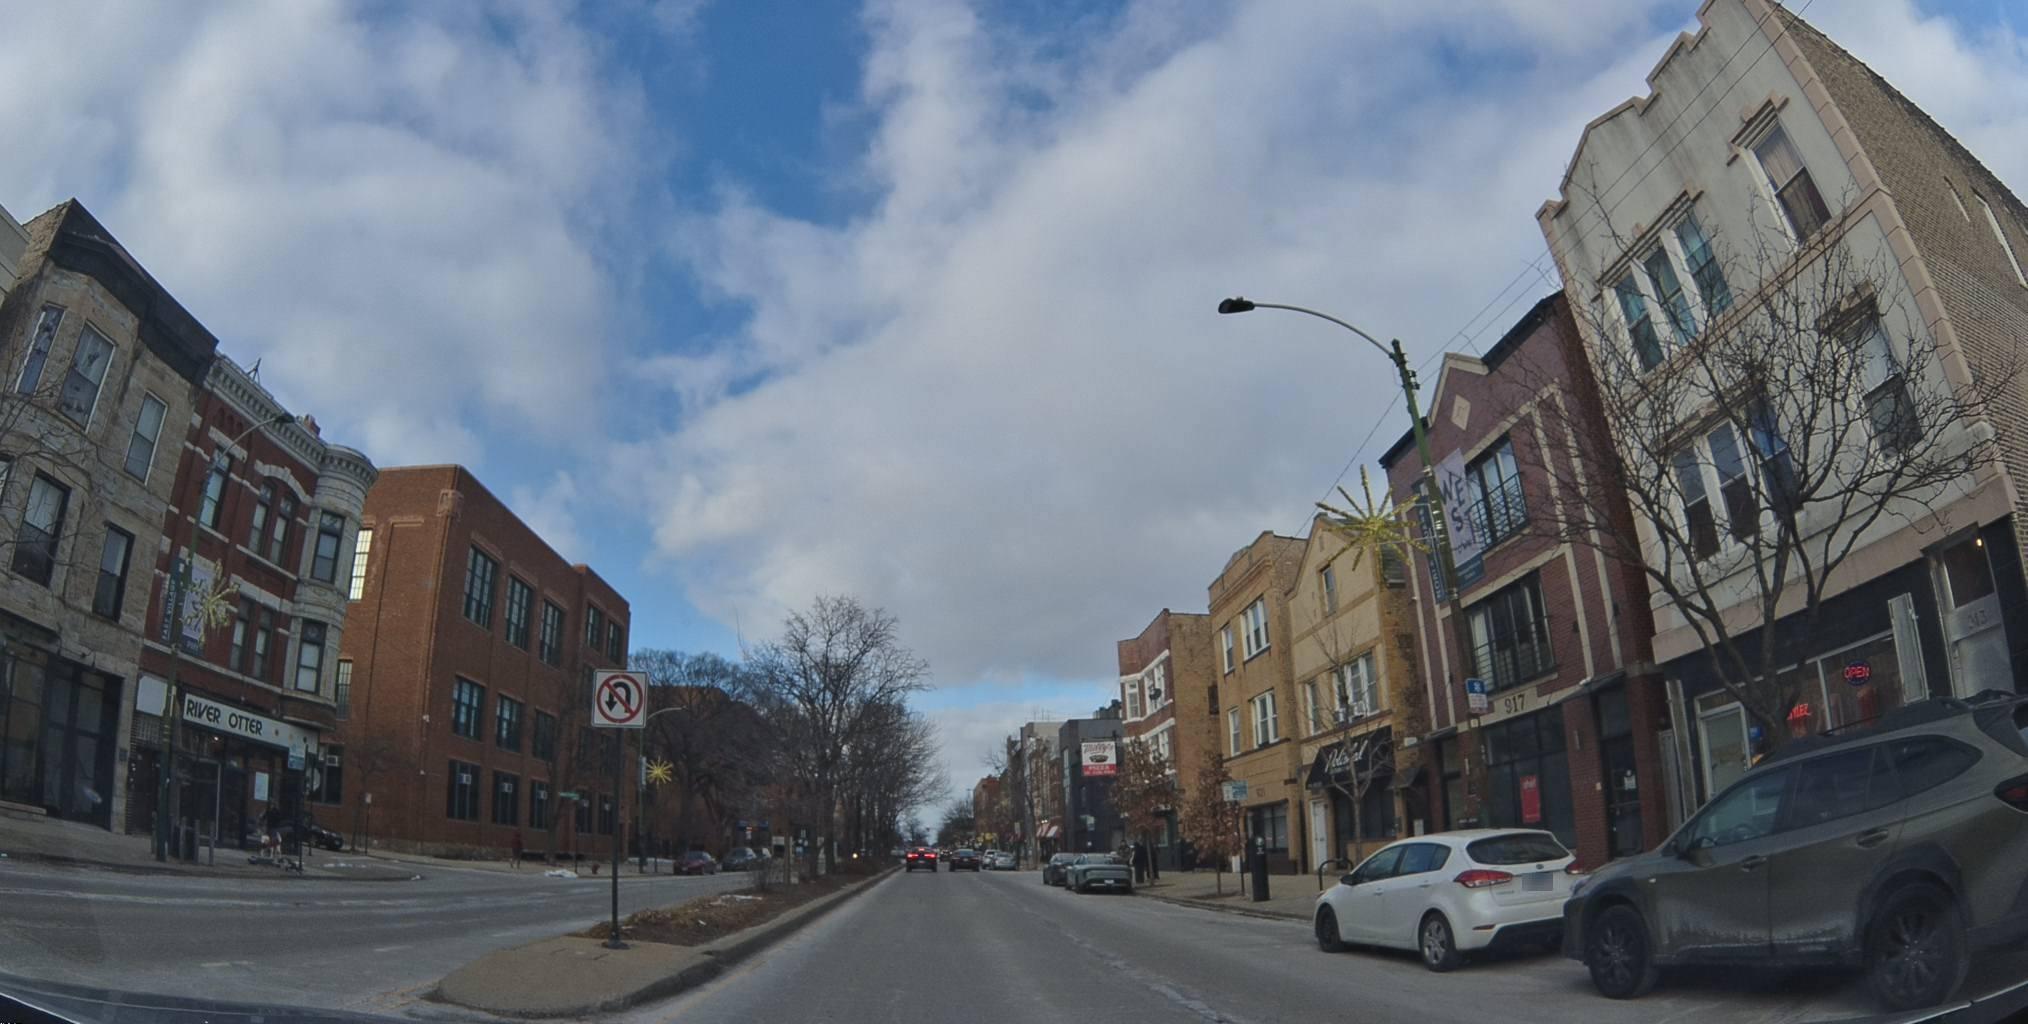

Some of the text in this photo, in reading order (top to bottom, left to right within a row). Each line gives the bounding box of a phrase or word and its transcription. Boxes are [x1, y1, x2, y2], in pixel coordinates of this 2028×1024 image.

[1844, 665, 1870, 679] OPEN
[1504, 694, 1526, 714] 917
[186, 700, 263, 736] RIVER OTTER
